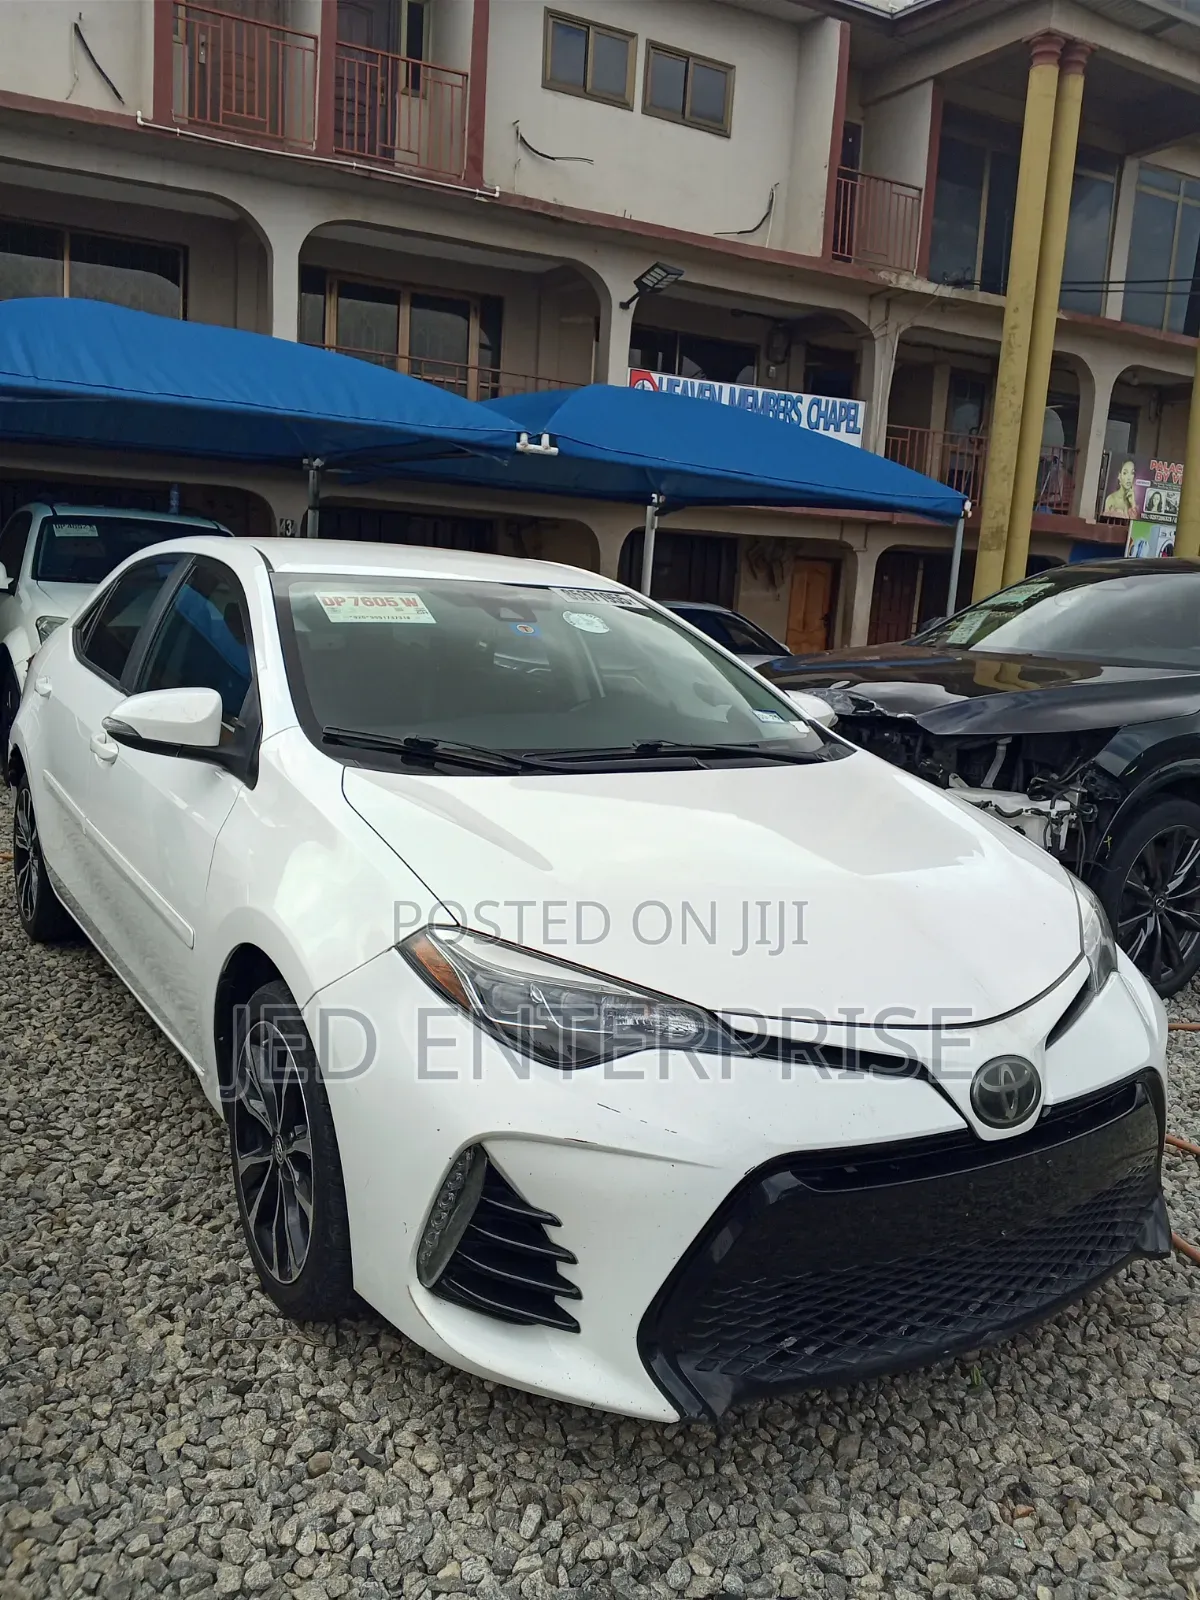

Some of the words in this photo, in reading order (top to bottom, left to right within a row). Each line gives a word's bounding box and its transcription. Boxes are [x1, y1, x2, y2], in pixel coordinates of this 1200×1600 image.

[729, 387, 803, 426] MEMBERS
[807, 397, 861, 435] CHAPEL
[1150, 460, 1184, 473] PALAC
[1155, 471, 1170, 482] BY
[320, 596, 346, 607] DP
[346, 596, 398, 607] 7605
[401, 597, 419, 607] W
